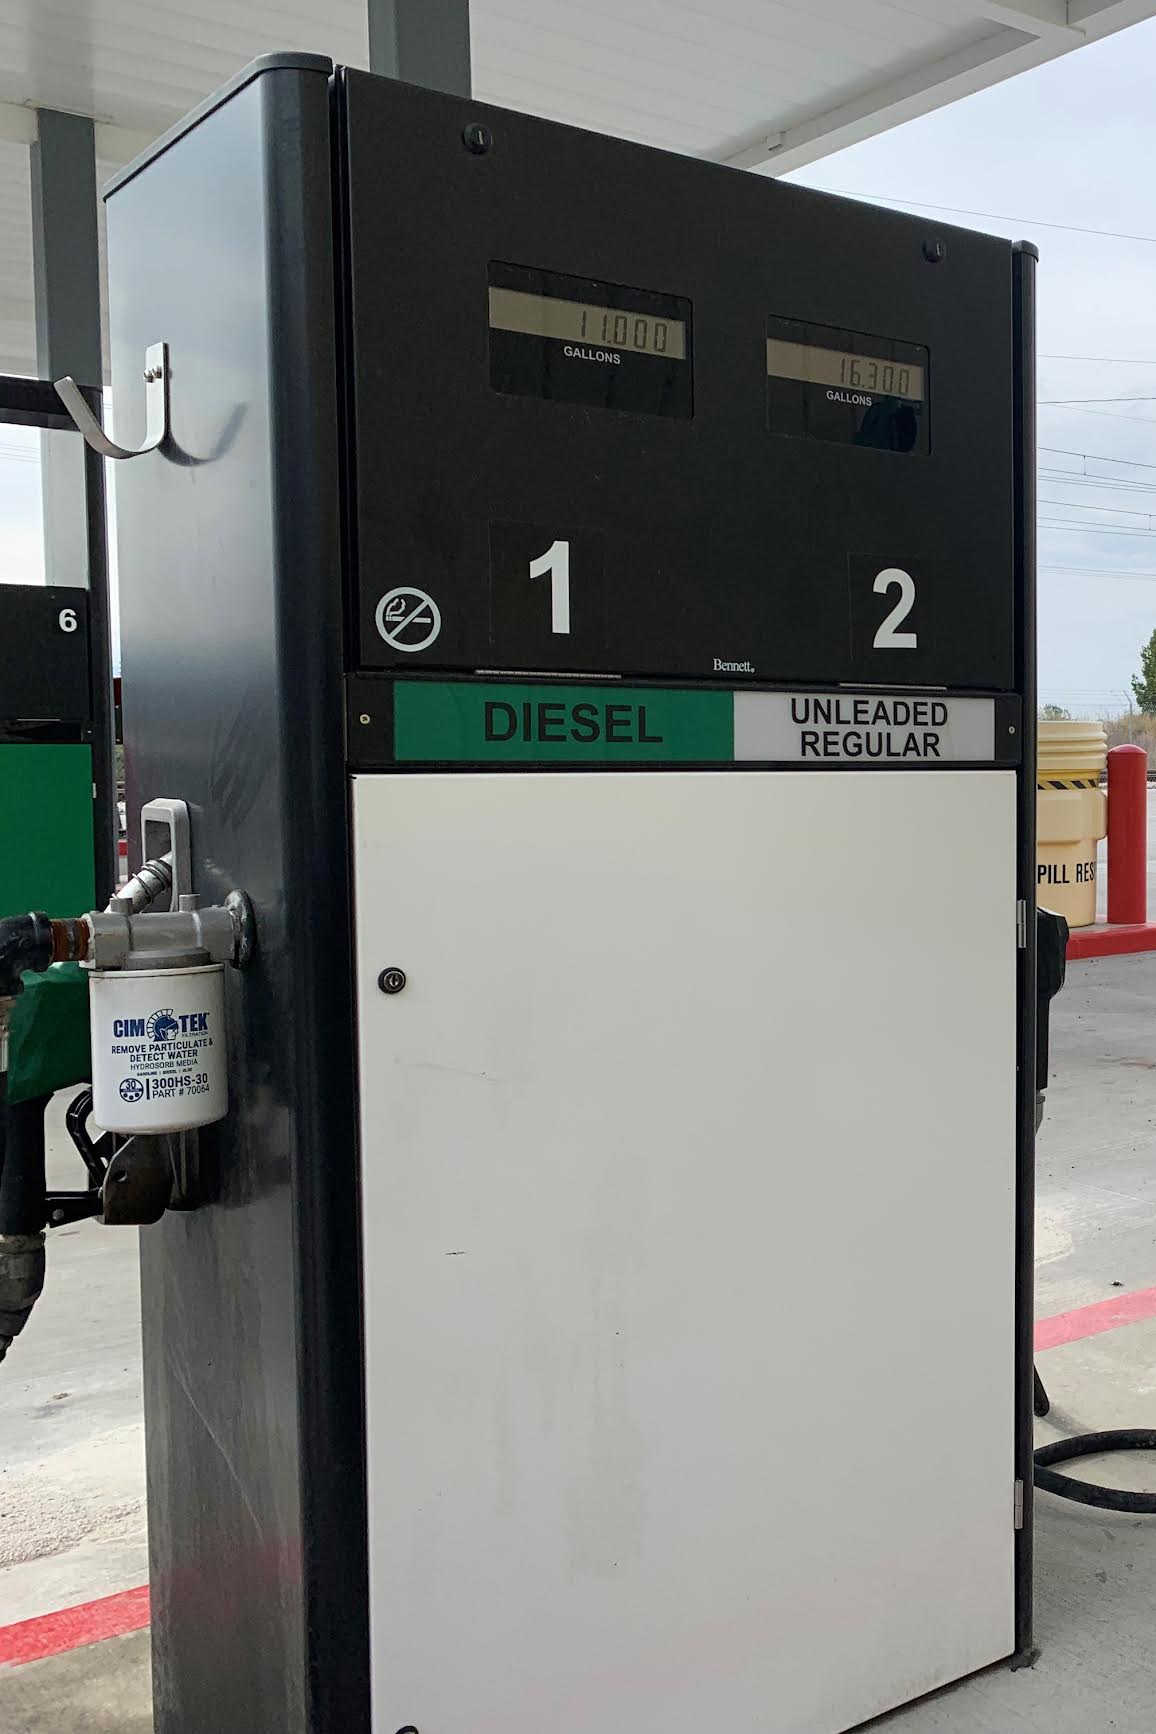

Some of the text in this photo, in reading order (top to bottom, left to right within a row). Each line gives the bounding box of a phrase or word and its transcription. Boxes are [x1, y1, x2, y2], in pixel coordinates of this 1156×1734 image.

[581, 311, 668, 352] 11.000
[563, 345, 621, 365] GALLONS
[840, 358, 910, 395] 16.300
[826, 390, 872, 407] GALLONS
[529, 540, 571, 634] 1
[873, 567, 918, 649] 2
[58, 608, 78, 633] 6
[484, 700, 663, 743] DIESEL
[791, 697, 948, 727] UNLEADED
[800, 730, 941, 757] REGULAR
[1037, 861, 1096, 884] PILL RES
[113, 1013, 209, 1038] CIM TEK
[111, 1044, 146, 1054] REMOVE
[149, 1039, 208, 1052] PARTICULATE
[130, 1049, 198, 1063] DETECT WATER
[130, 1058, 198, 1070] HYDROSORB MEDIA
[125, 1080, 136, 1089] 30
[152, 1073, 208, 1090] 300HS-30
[152, 1088, 176, 1099] PART
[179, 1088, 184, 1096] #
